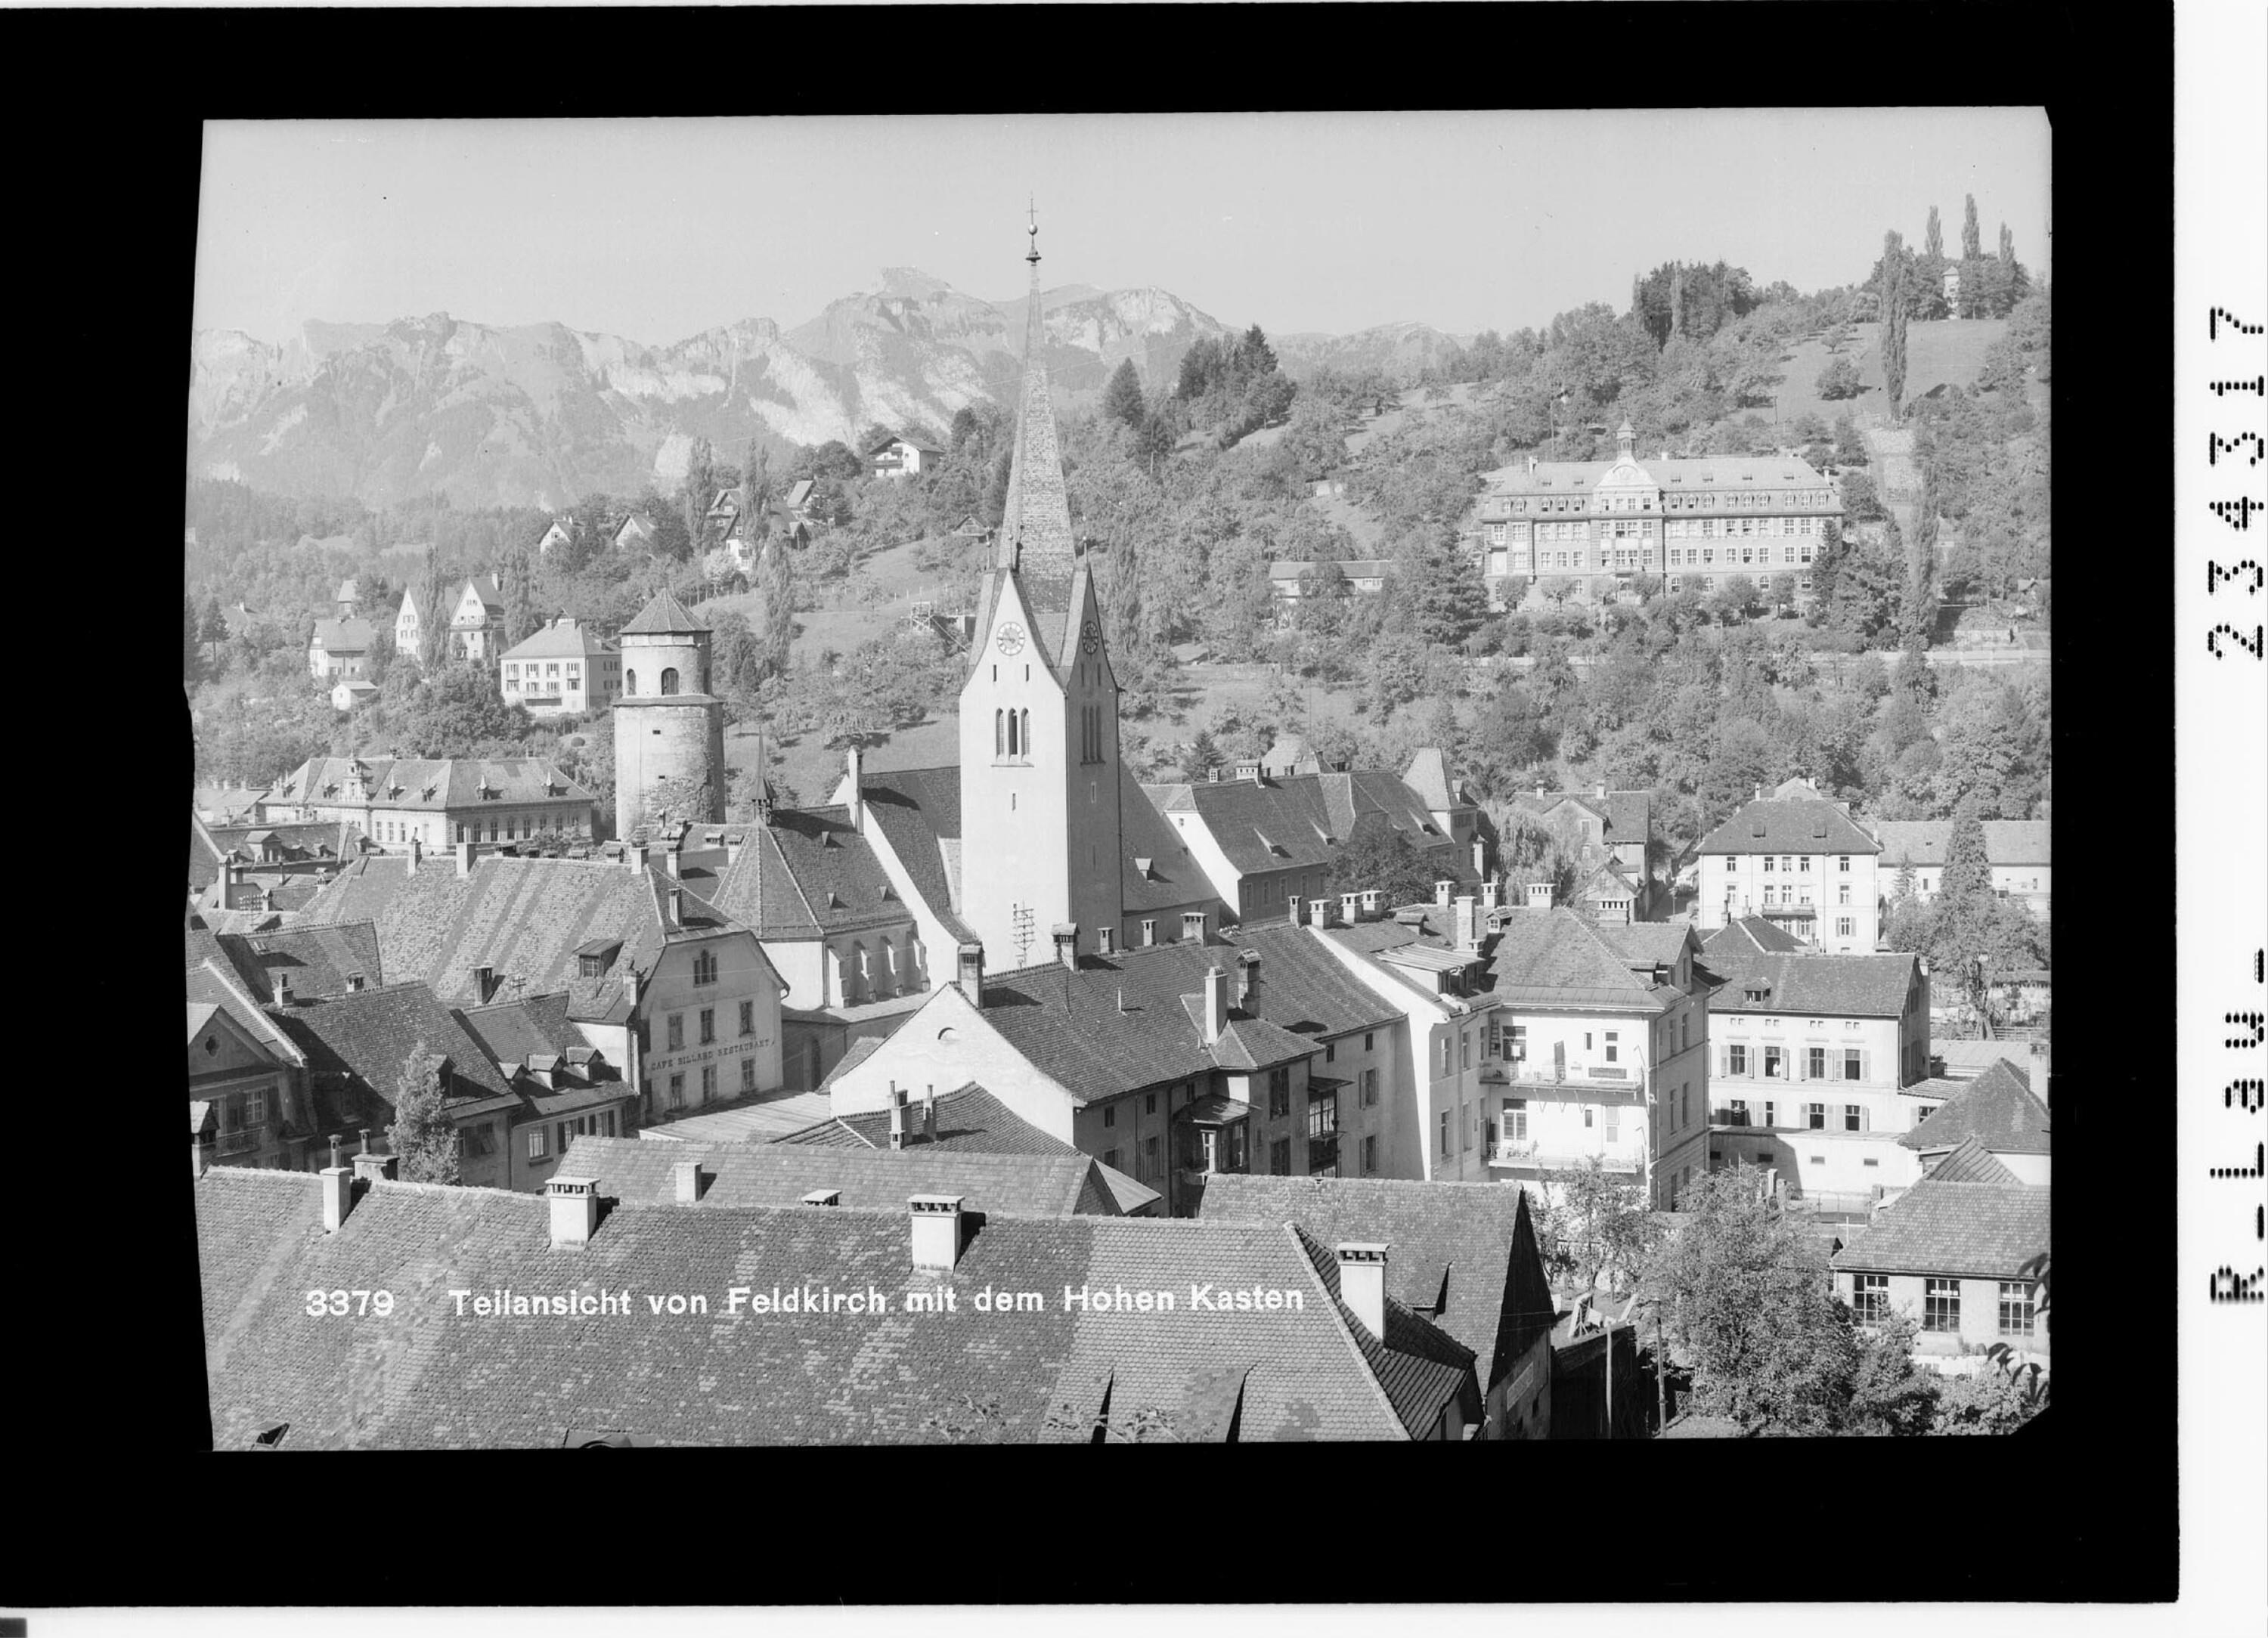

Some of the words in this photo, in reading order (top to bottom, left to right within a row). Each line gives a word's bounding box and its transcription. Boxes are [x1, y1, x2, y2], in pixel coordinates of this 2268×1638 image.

[2207, 308, 2265, 661] 234317
[677, 1050, 714, 1065] BILLARD
[717, 1039, 770, 1057] RESTAURANT
